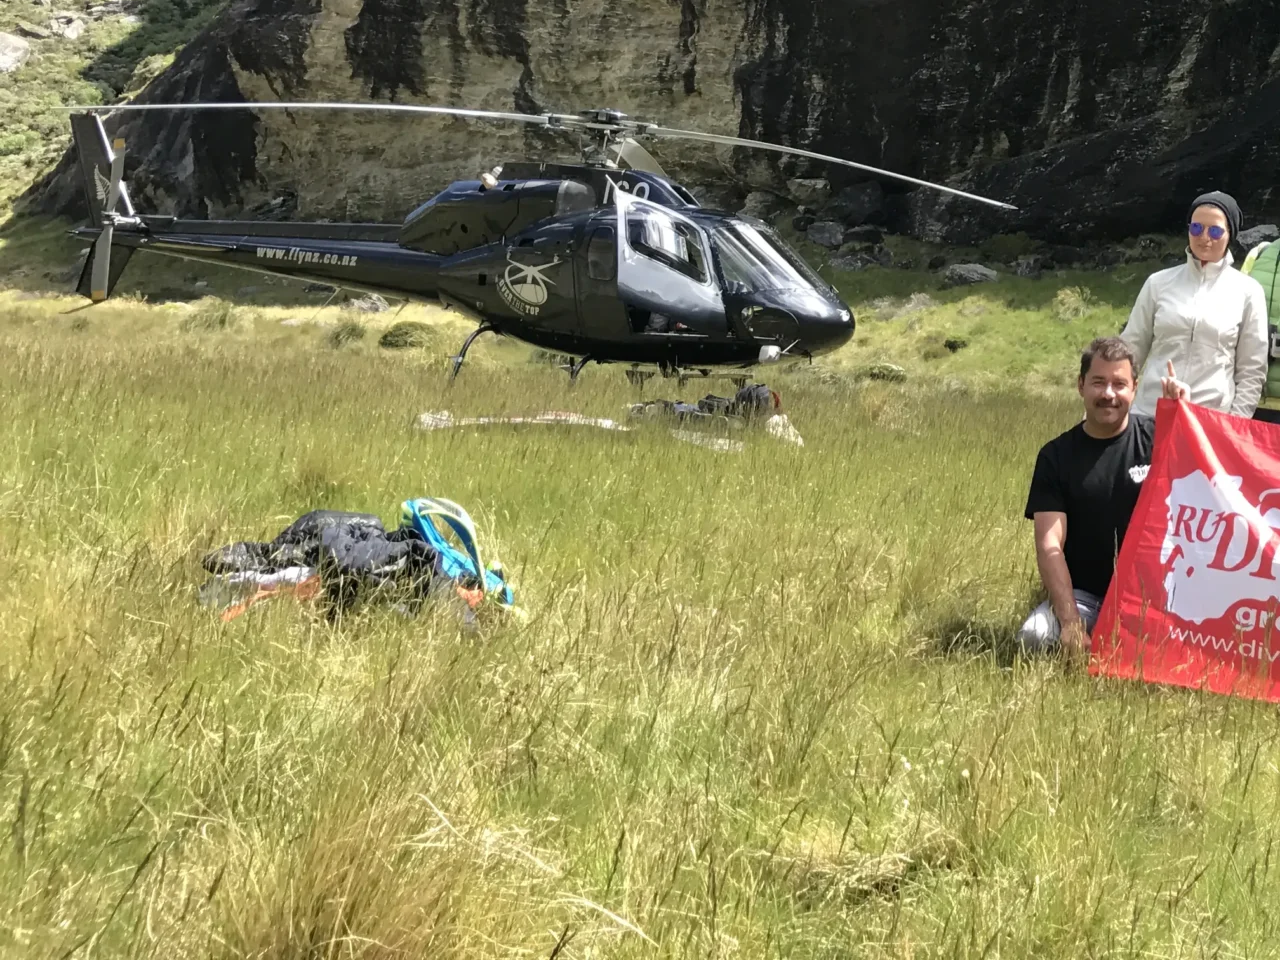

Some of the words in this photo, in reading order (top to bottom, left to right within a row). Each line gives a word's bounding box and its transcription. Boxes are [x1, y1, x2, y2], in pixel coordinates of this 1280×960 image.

[256, 246, 358, 266] www.flynz.co.nz
[498, 279, 513, 302] OVER
[511, 297, 525, 312] THE
[524, 304, 540, 316] TOP
